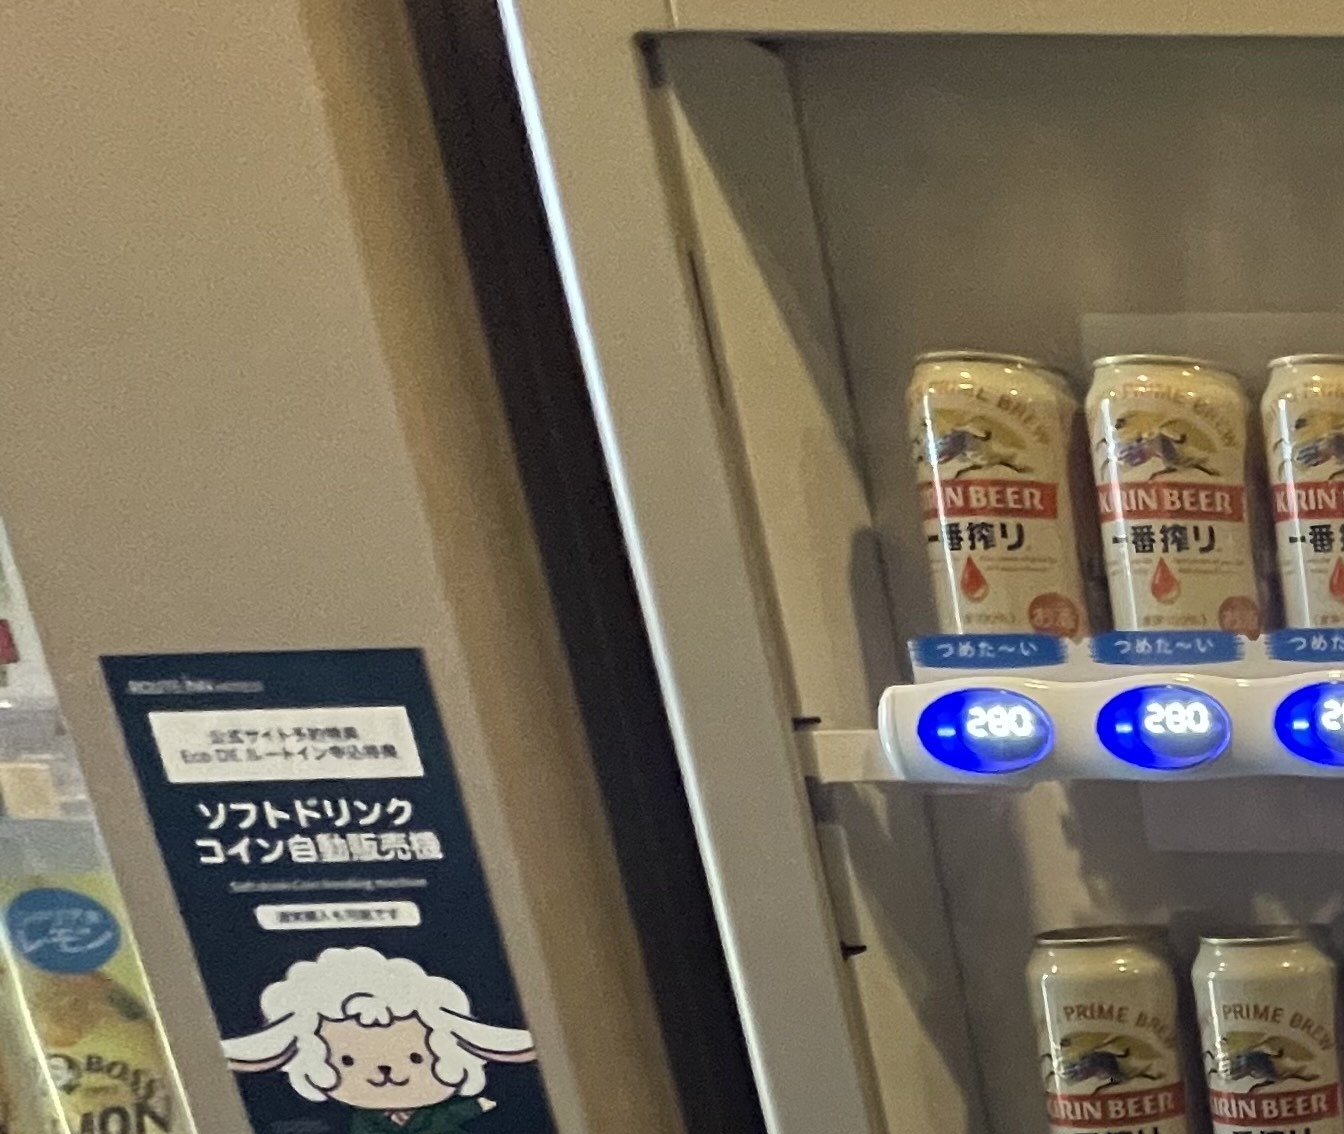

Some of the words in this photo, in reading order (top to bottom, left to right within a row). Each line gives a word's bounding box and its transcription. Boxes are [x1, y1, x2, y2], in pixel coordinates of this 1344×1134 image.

[970, 487, 1044, 510] BEER
[1162, 490, 1232, 513] BEER
[1112, 525, 1215, 553] 一番搾り
[967, 705, 1035, 738] 280
[1144, 702, 1210, 733] 280
[196, 798, 414, 829] ソフトドリンク
[195, 830, 444, 864] コイン自動販売機
[1063, 1003, 1129, 1024] PRIME
[1222, 1003, 1283, 1024] PRIME
[1109, 1092, 1175, 1119] BEER
[1262, 1094, 1327, 1119] BEER
